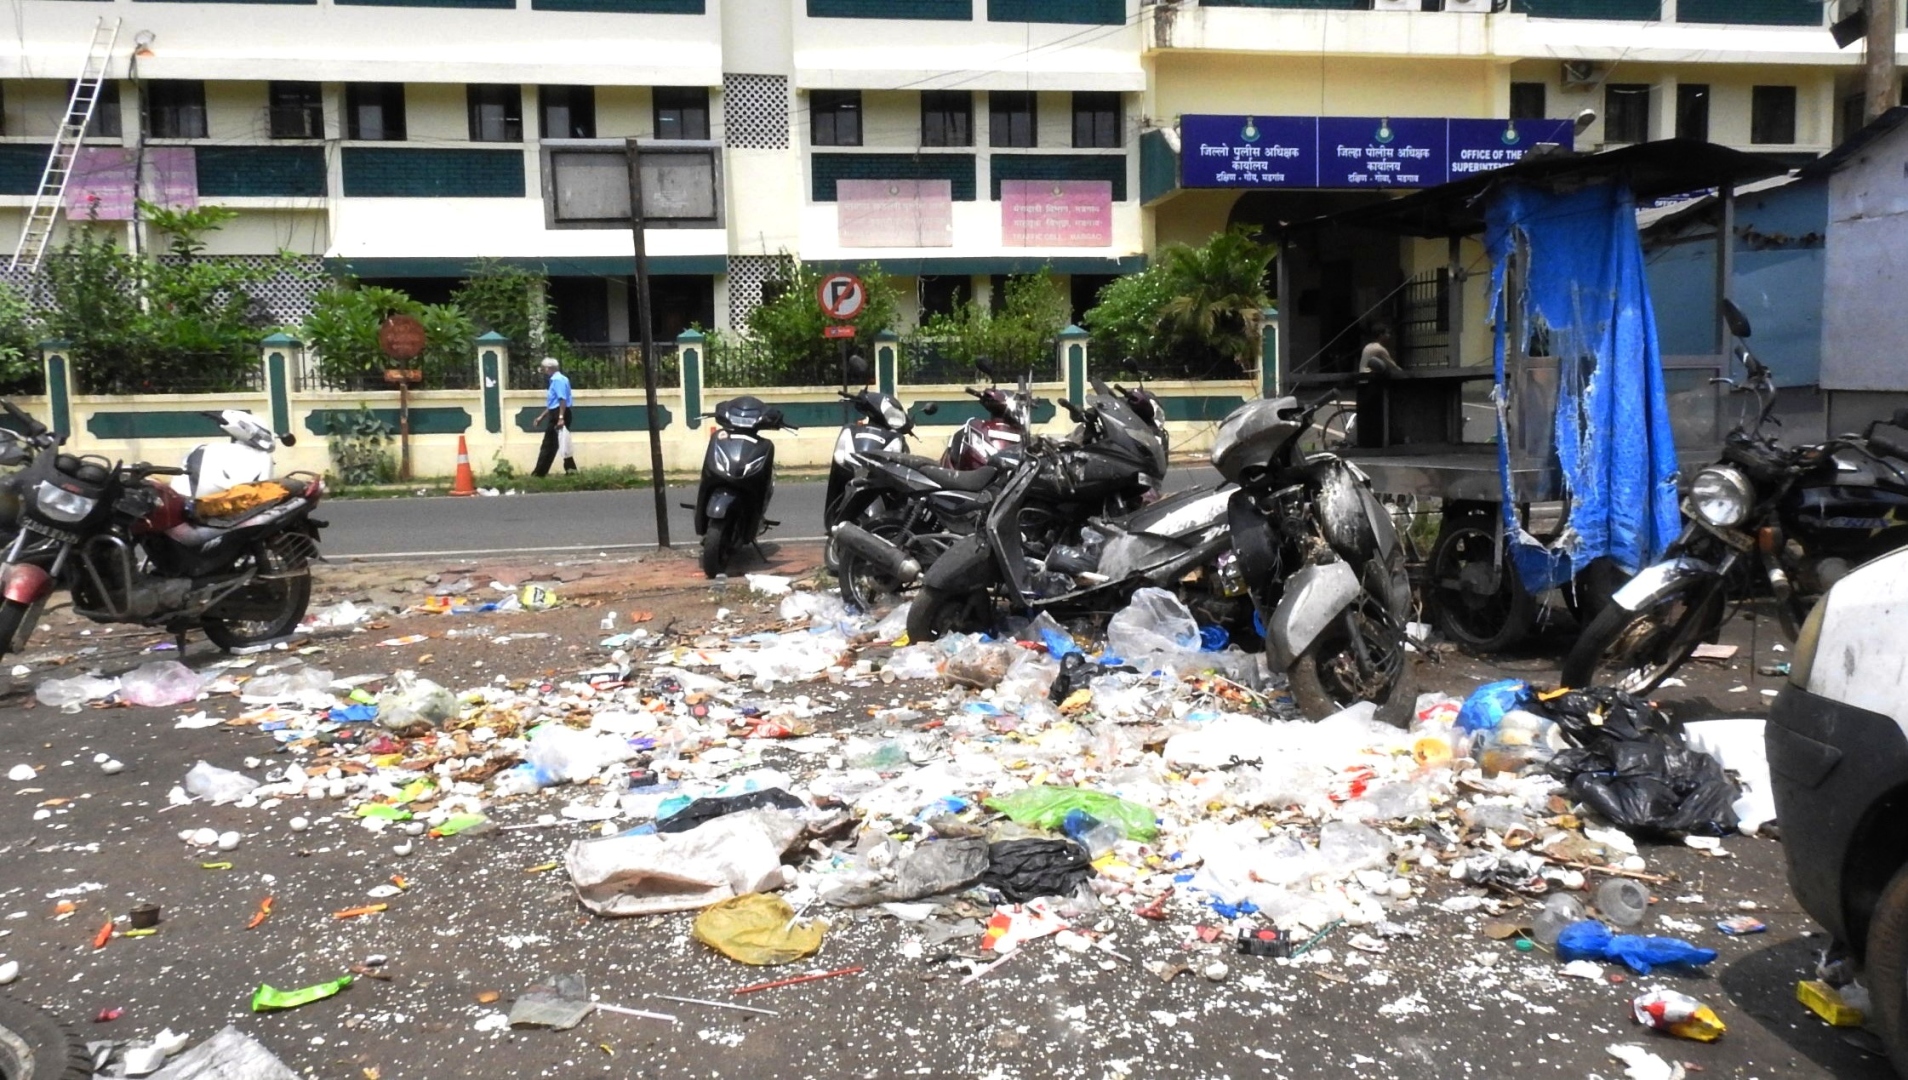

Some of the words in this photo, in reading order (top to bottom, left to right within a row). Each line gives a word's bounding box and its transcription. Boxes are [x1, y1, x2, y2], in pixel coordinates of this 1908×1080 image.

[1233, 144, 1261, 161] पुलीस
[1337, 144, 1362, 159] जिल्हा
[1365, 144, 1394, 158] पोलीस
[1461, 149, 1491, 160] OFFICE
[1492, 150, 1504, 160] OF
[1506, 150, 1523, 160] THE
[1231, 157, 1268, 171] कार्यालय
[1366, 158, 1401, 171] कार्यालय
